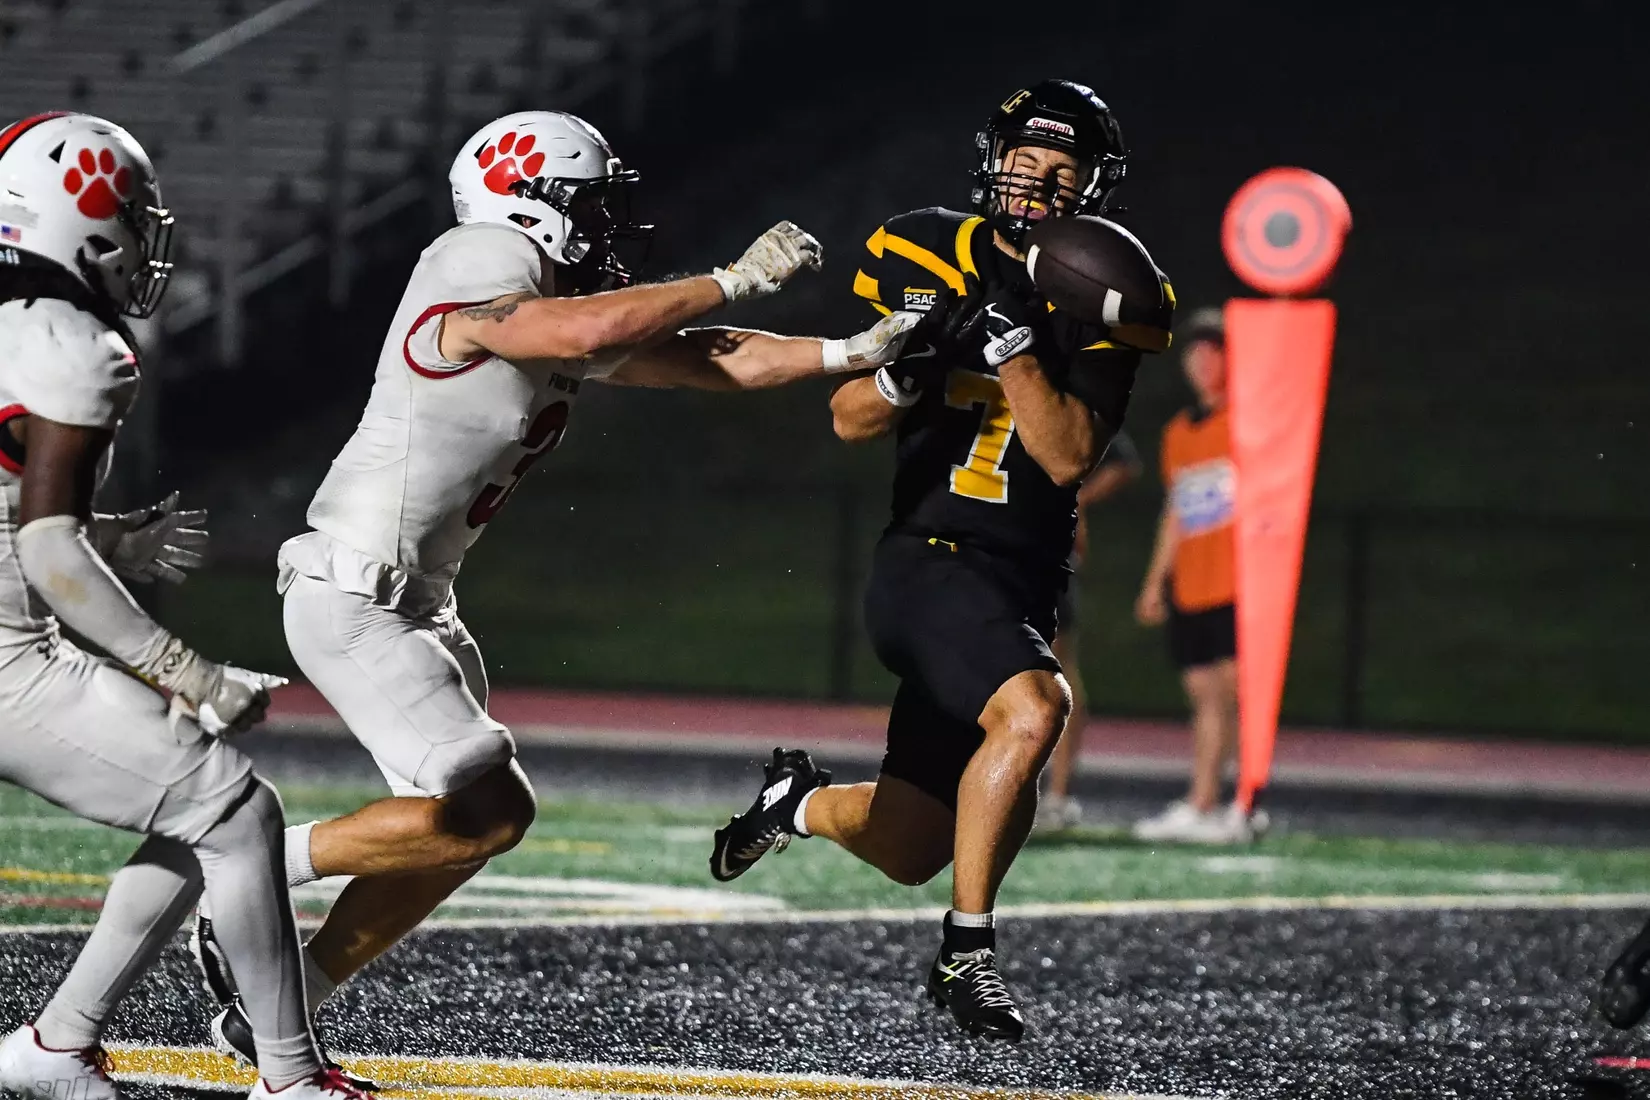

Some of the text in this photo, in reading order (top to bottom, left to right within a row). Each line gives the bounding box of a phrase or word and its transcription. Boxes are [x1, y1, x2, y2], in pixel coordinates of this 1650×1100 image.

[1032, 119, 1071, 134] Riddell
[903, 293, 937, 305] PSAC
[997, 330, 1028, 355] BATTLE
[944, 369, 1015, 504] 7
[762, 775, 793, 812] NIKE
